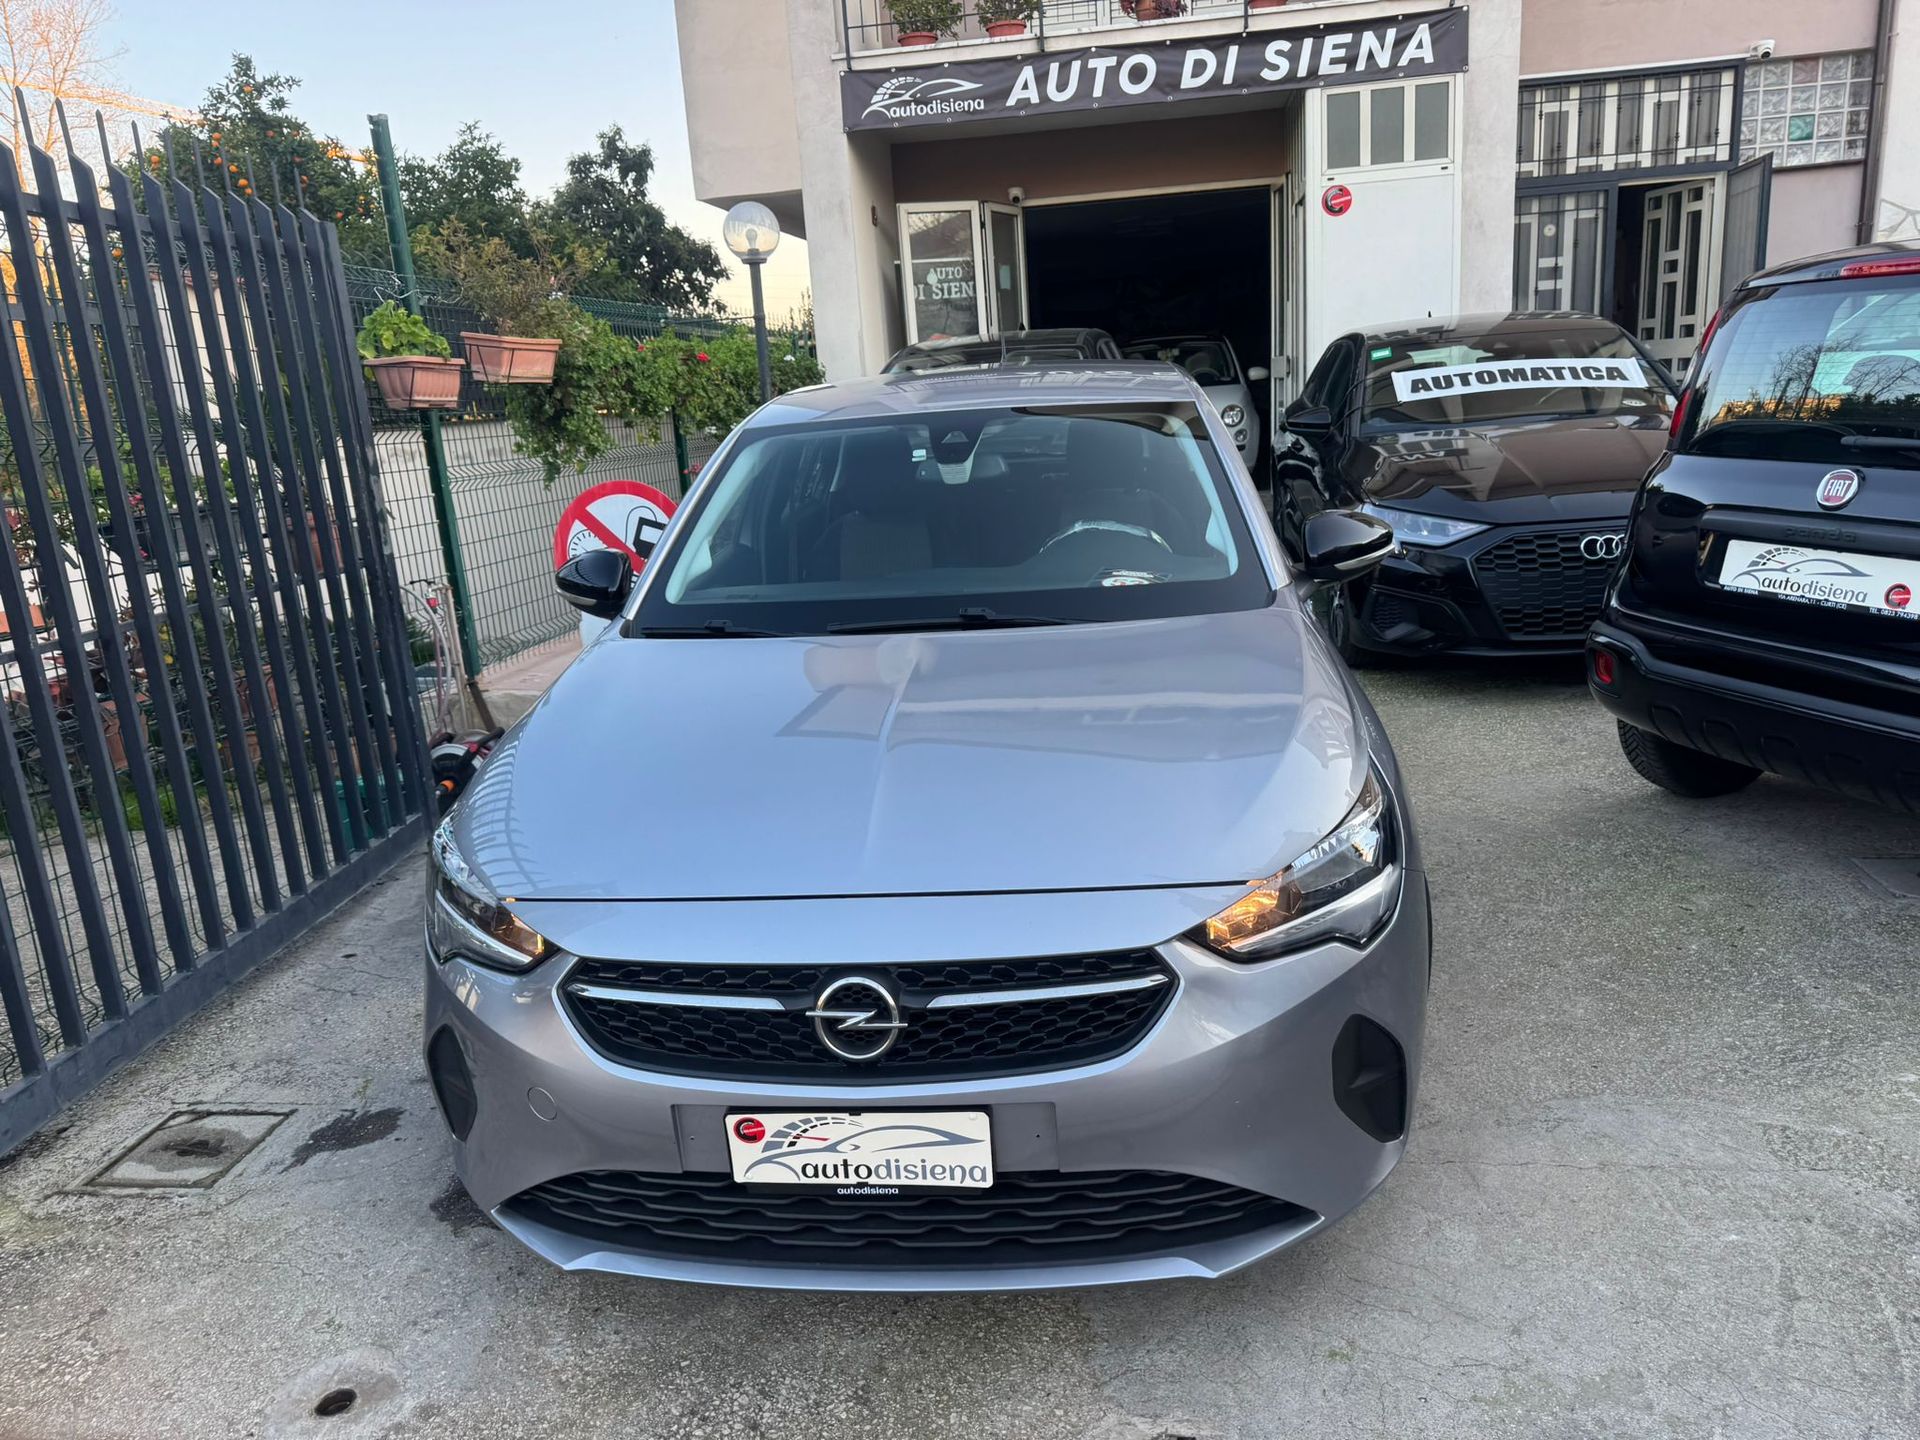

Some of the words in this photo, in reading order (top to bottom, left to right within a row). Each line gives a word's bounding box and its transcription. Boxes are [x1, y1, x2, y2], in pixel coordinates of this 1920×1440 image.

[1005, 54, 1157, 106] AUTO
[1180, 45, 1239, 89] DI
[1260, 23, 1435, 81] SIENA
[890, 98, 985, 118] autodisiena
[1409, 365, 1630, 394] AUTOMATICA
[1824, 479, 1852, 497] FIAT
[1761, 577, 1868, 602] autodisiena
[801, 1158, 988, 1184] autodisiena
[837, 1186, 899, 1195] autodisiena
